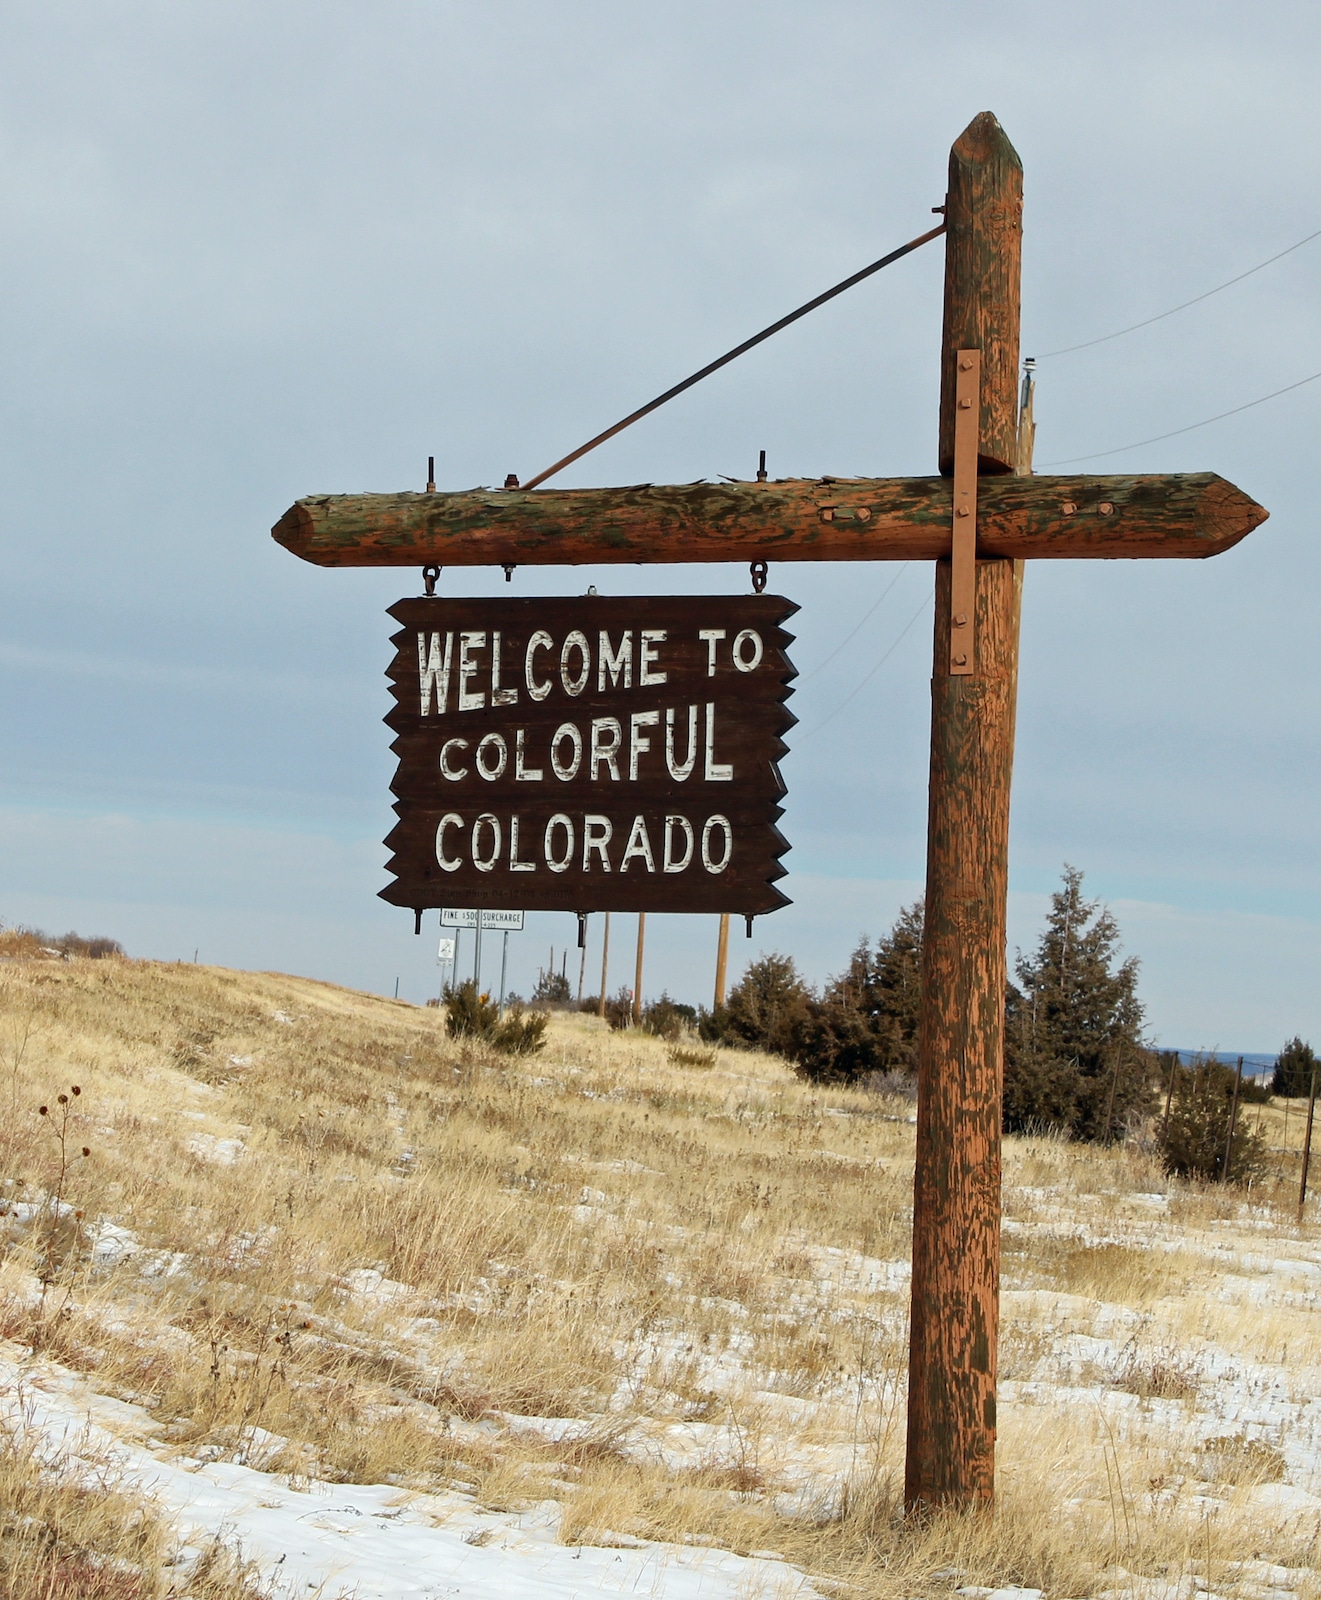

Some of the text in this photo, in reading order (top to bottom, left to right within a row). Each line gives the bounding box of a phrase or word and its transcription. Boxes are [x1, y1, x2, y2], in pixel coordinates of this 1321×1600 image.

[417, 629, 763, 716] WELCOME TO
[440, 702, 733, 781] COLORFUL
[435, 813, 733, 874] COLORADO
[443, 910, 458, 920] FINE
[483, 912, 521, 923] SURCHARGE
